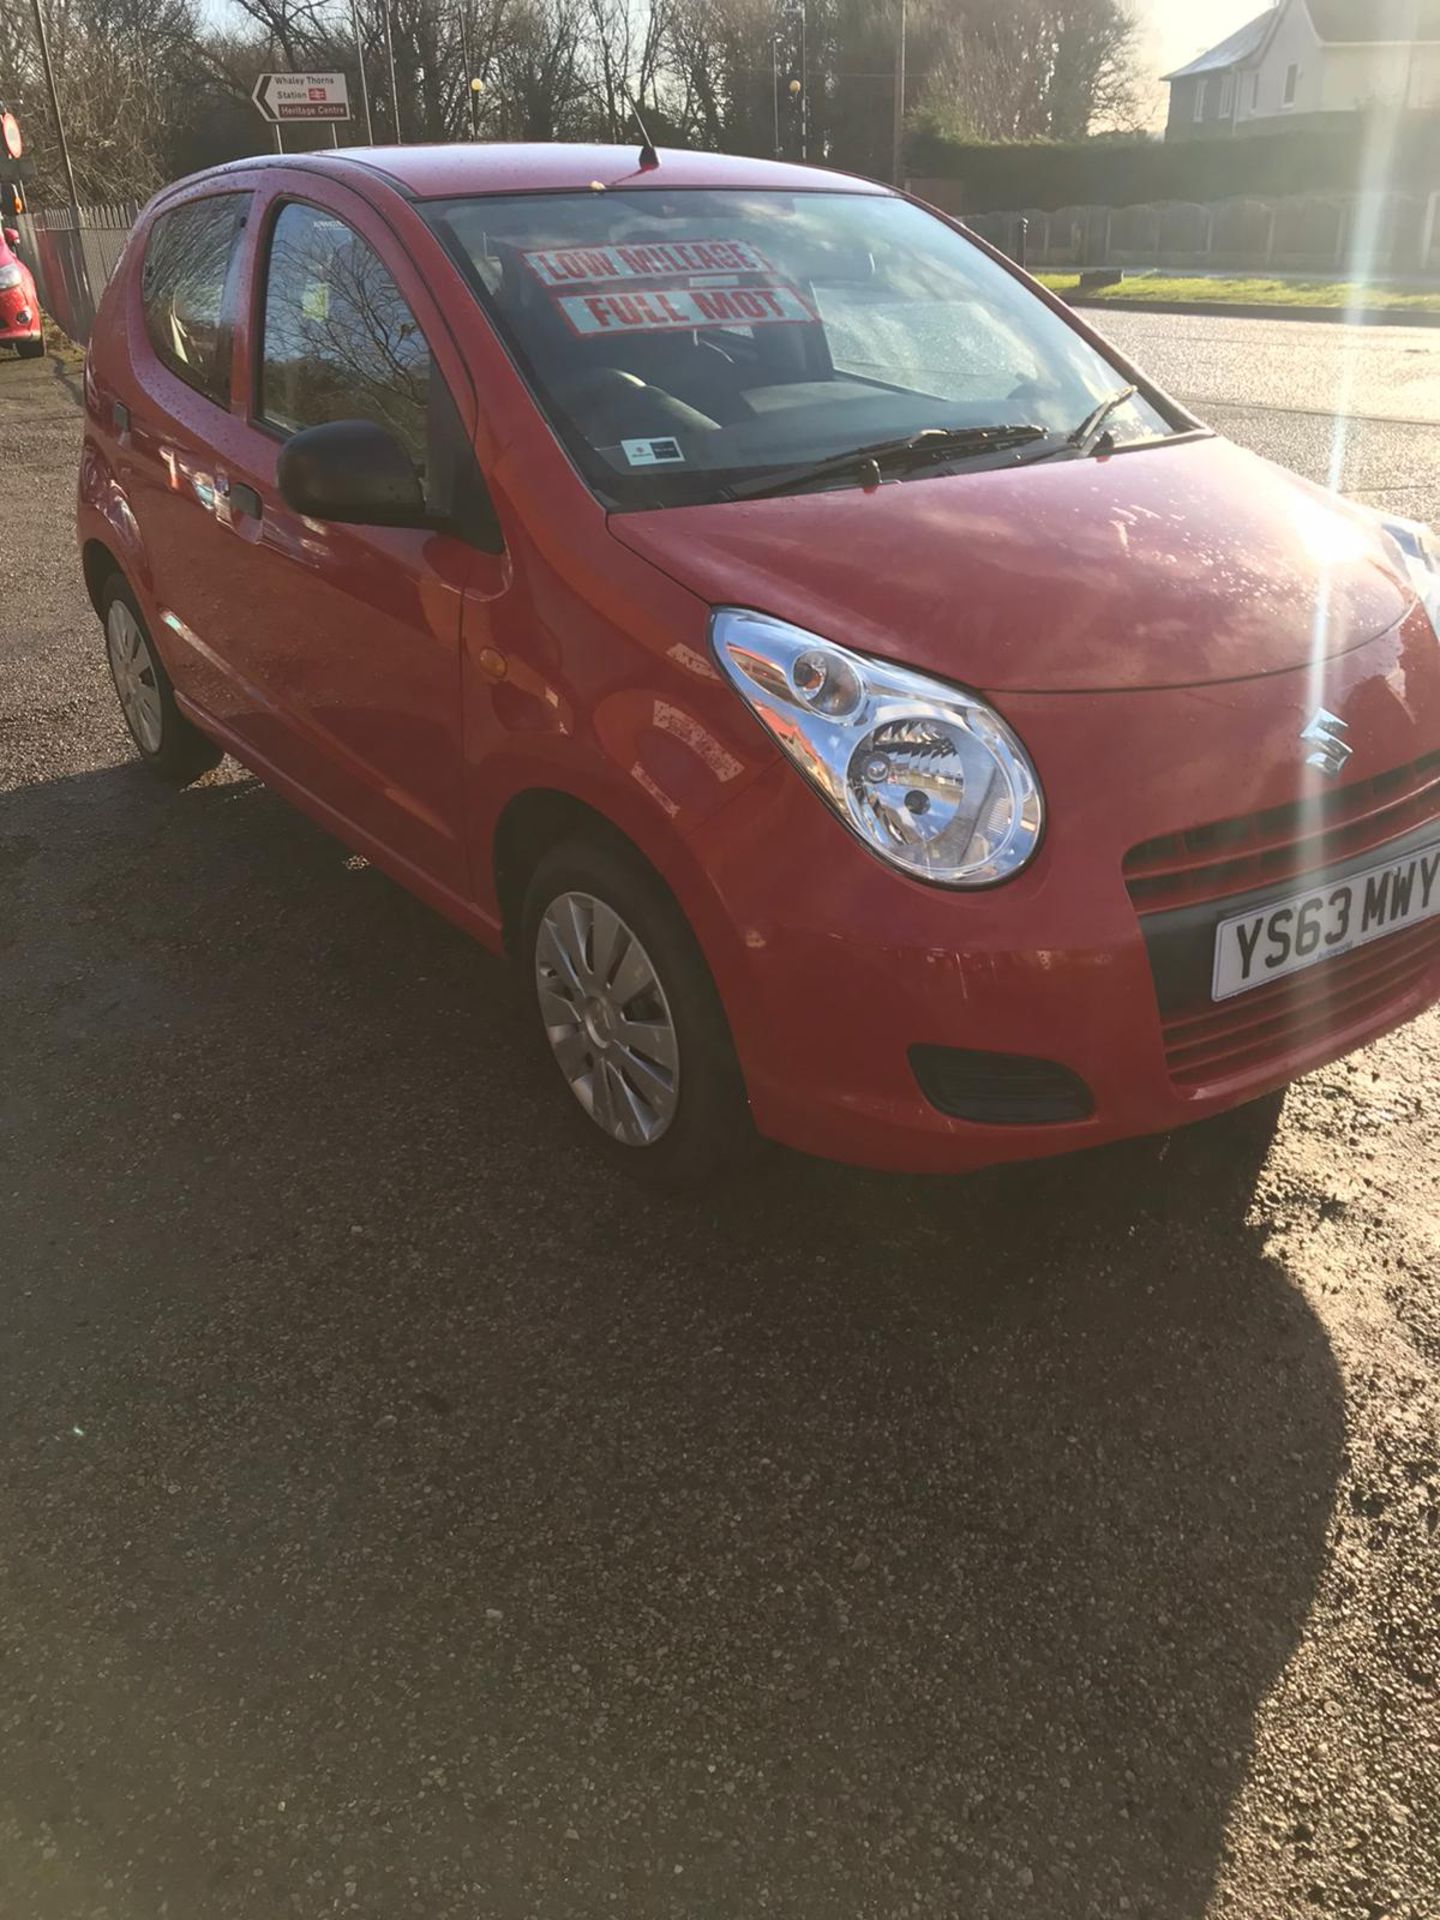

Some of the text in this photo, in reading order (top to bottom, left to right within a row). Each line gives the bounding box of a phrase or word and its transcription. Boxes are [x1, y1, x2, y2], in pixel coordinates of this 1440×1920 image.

[274, 76, 335, 86] Whaley Thorns
[277, 90, 307, 99] Station
[281, 105, 345, 116] Heritage Centre
[538, 243, 759, 280] LOW MILEAGE
[583, 290, 786, 327] FULL MOT
[1236, 852, 1440, 980] YS63 MWY
